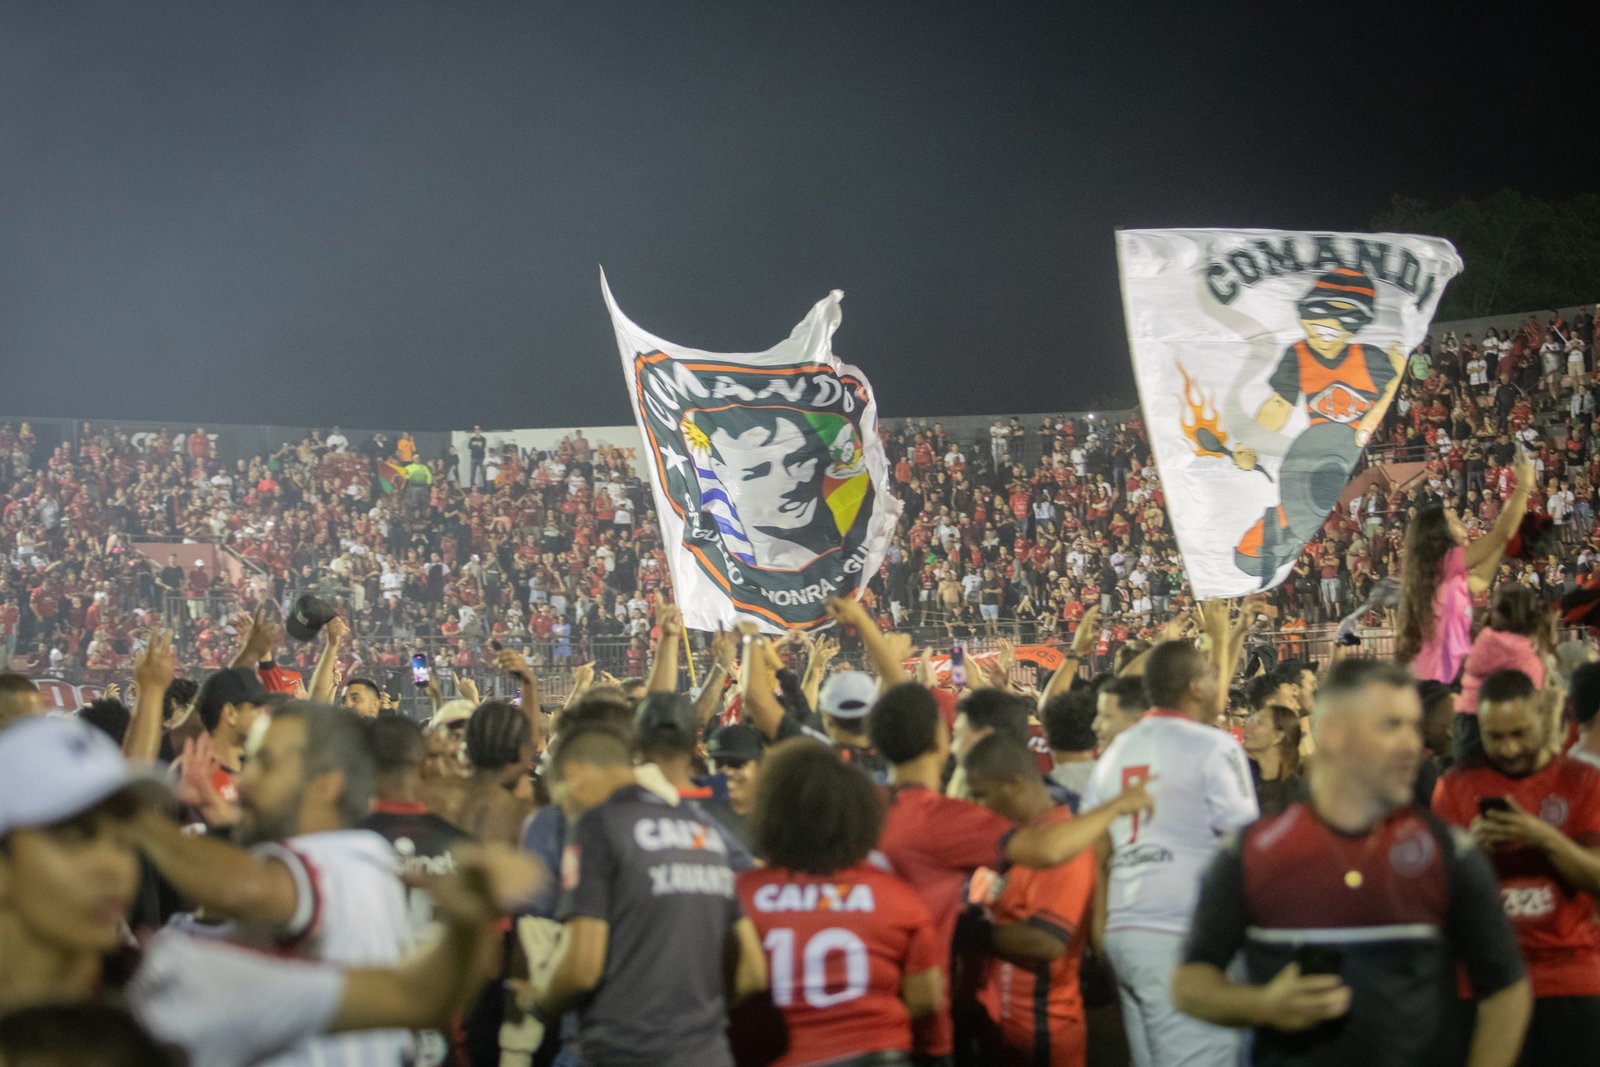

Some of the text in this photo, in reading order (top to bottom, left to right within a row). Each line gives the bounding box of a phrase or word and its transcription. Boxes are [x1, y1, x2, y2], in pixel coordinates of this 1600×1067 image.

[1206, 236, 1436, 313] COMAND
[633, 817, 729, 856] CAIXA
[753, 883, 876, 913] CAIXA
[763, 926, 870, 1010] 10
